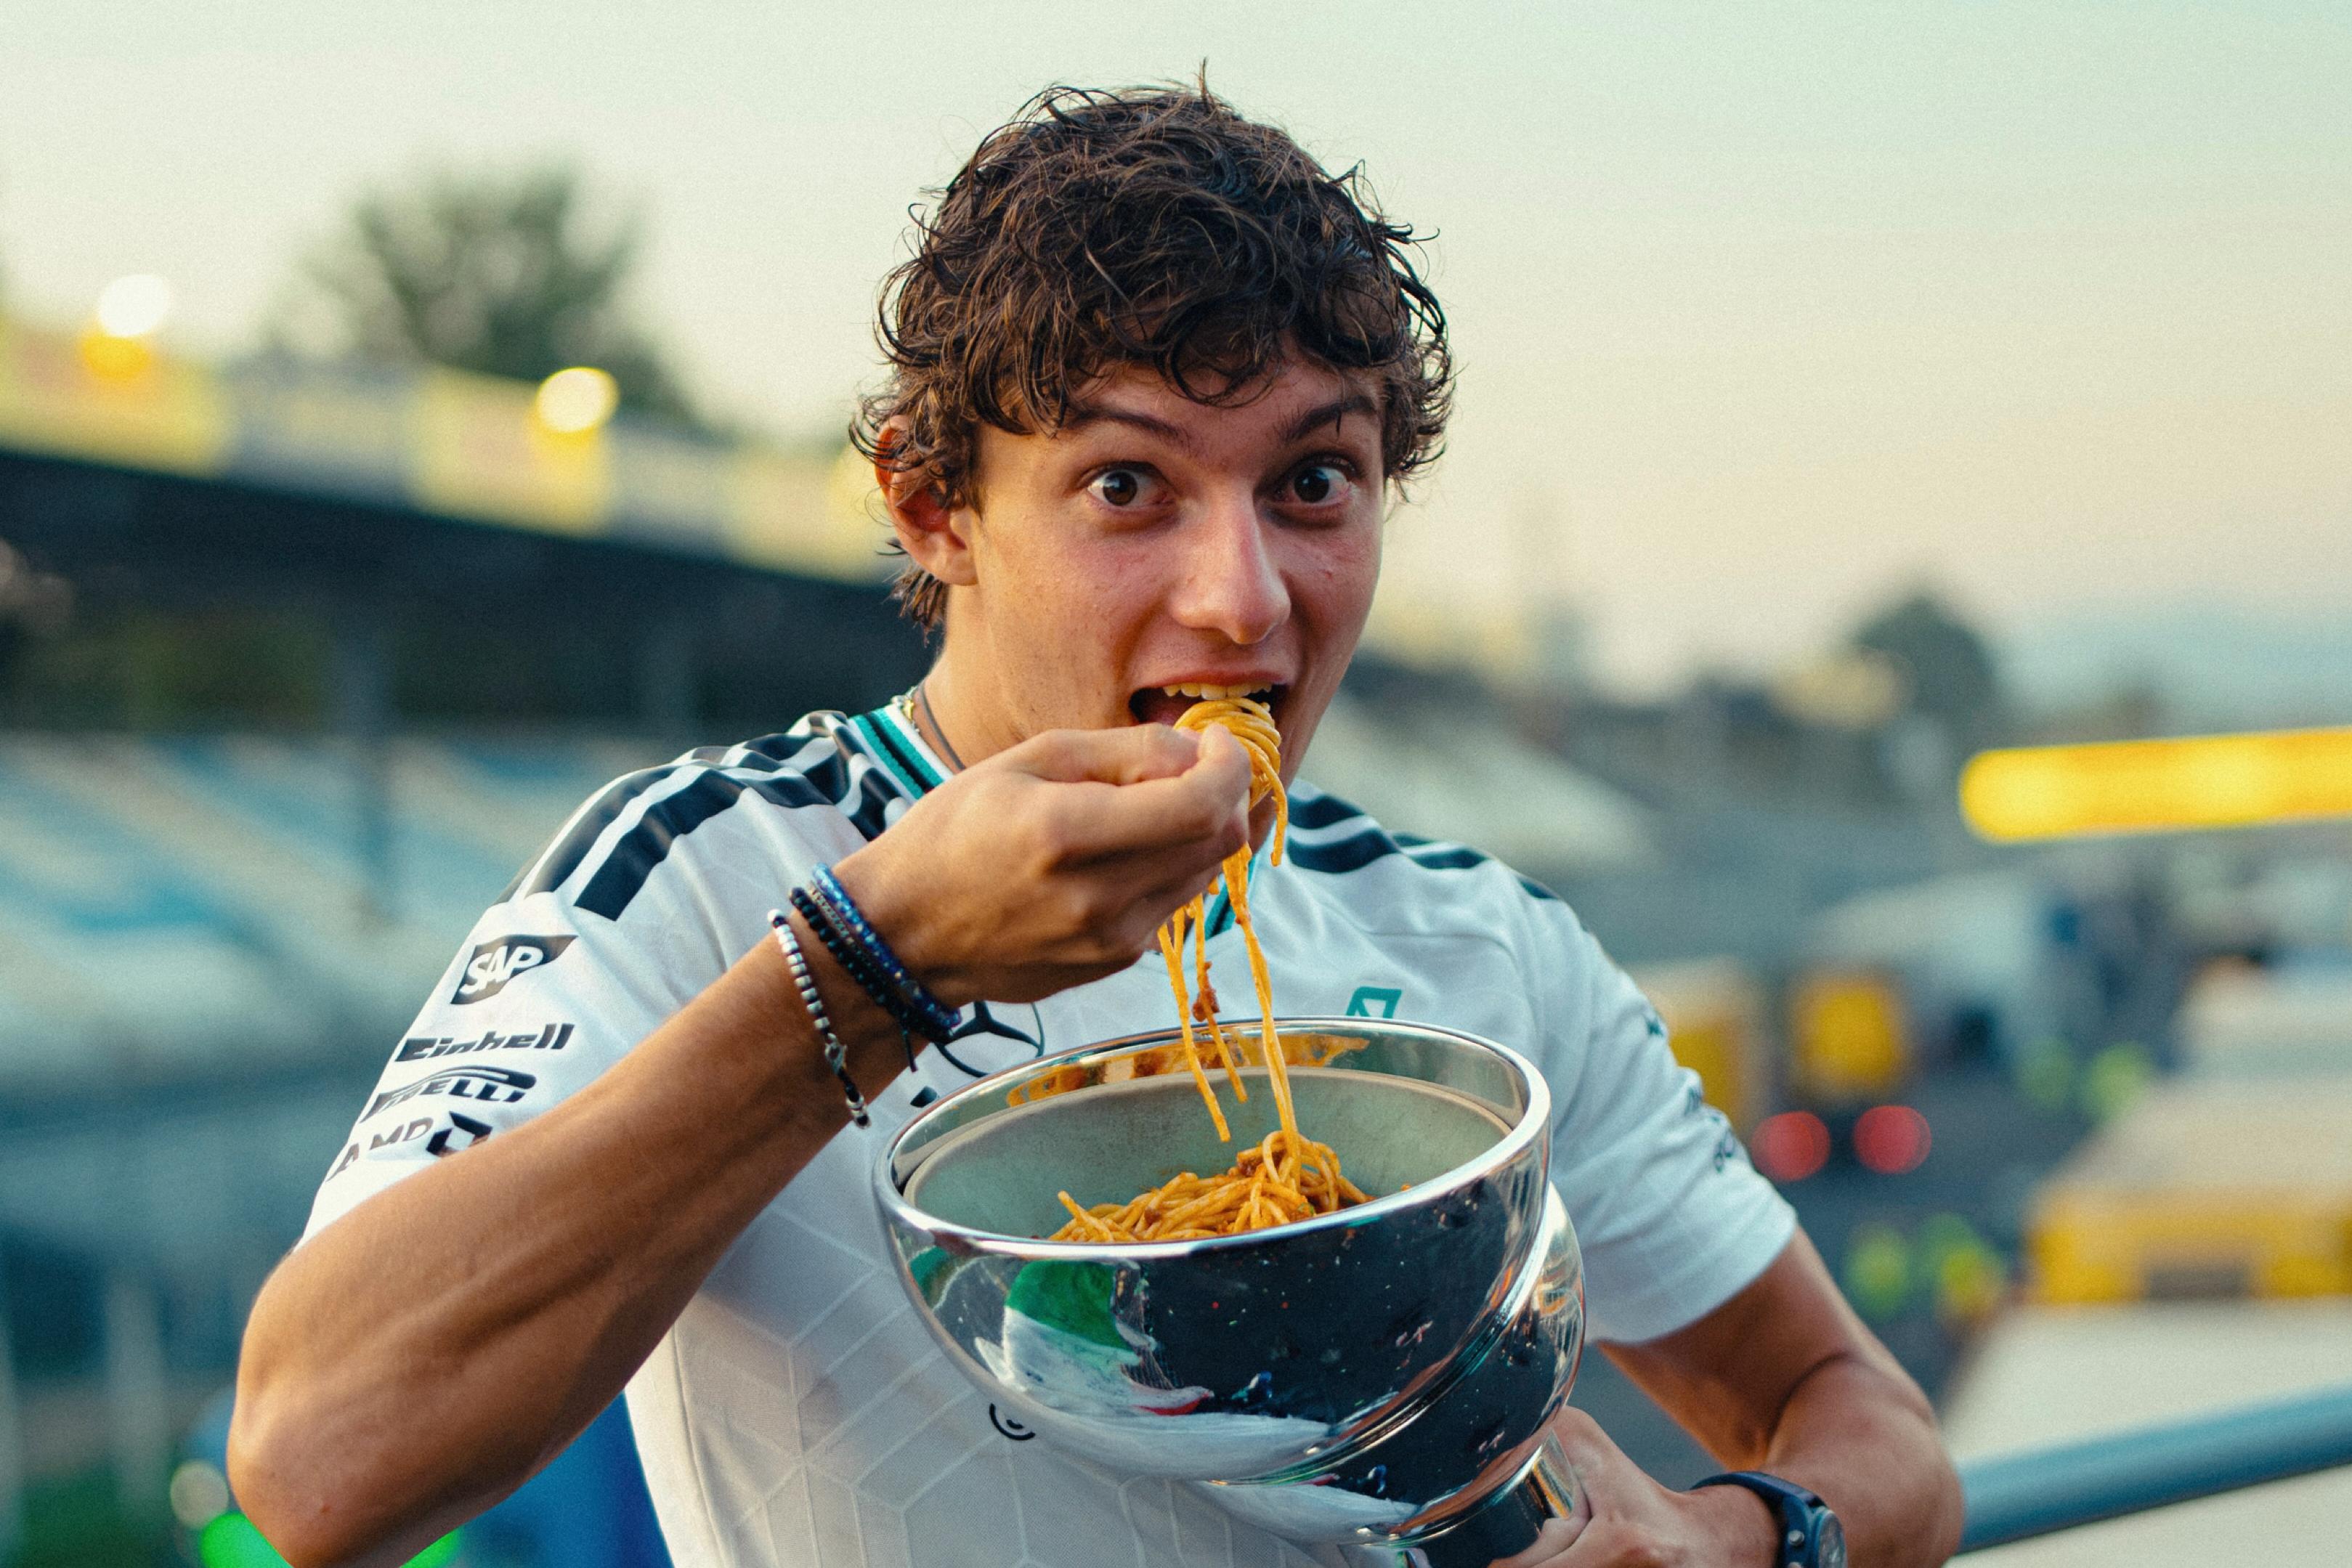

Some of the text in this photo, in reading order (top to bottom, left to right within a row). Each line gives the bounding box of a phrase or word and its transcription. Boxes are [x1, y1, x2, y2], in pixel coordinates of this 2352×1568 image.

[459, 945, 544, 994] SAP
[394, 1023, 576, 1063] Einhell
[359, 1065, 537, 1124] PIRELLI
[325, 1116, 434, 1183] AMD
